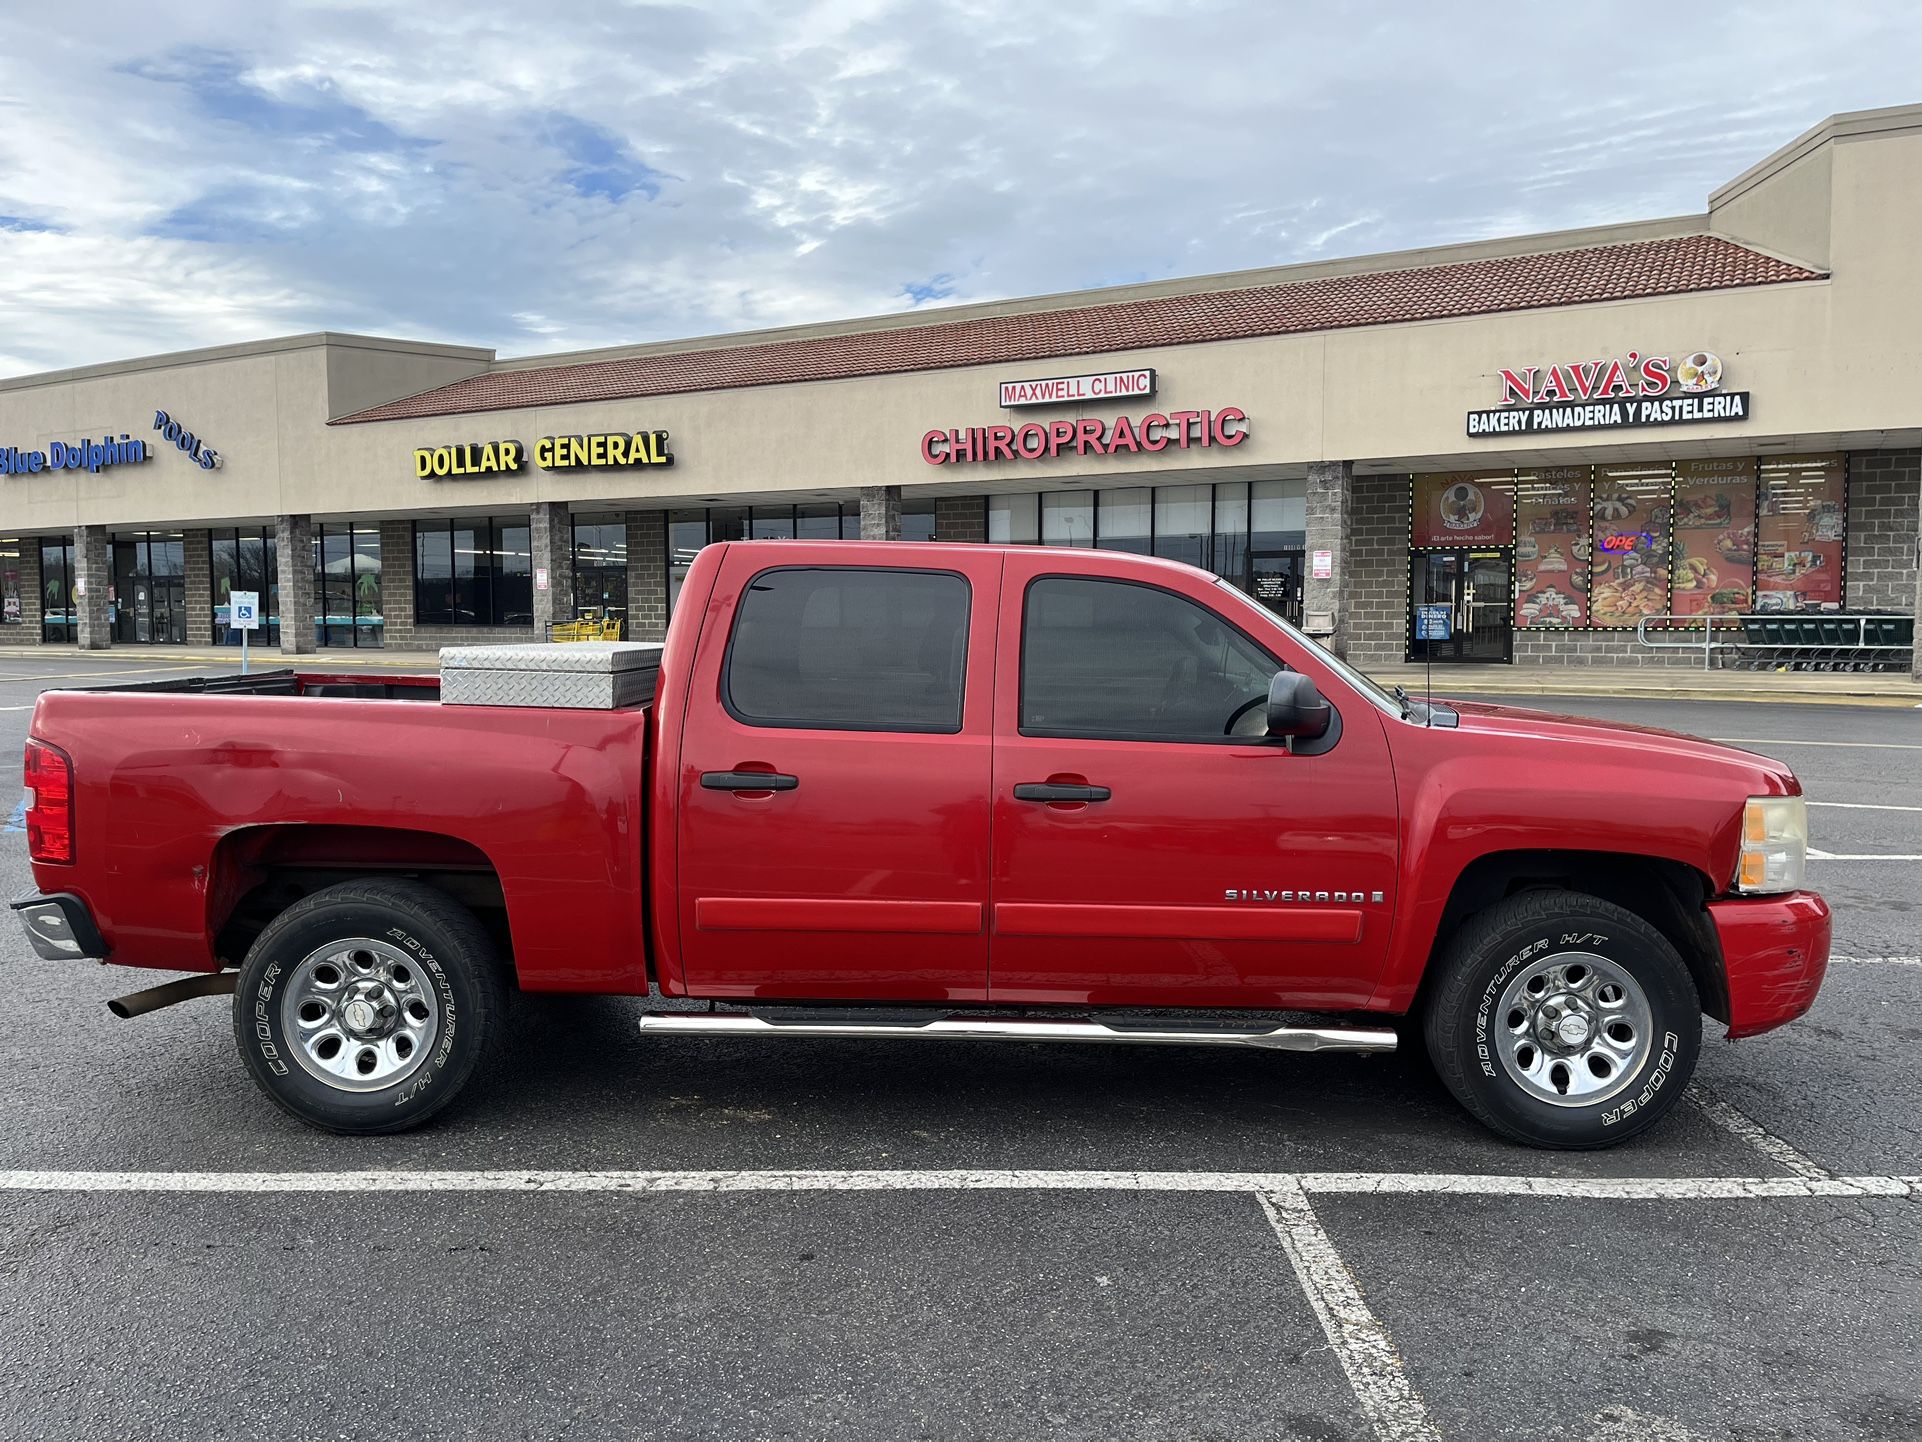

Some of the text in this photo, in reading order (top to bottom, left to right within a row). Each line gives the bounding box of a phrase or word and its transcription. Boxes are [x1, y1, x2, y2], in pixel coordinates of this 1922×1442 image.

[1003, 372, 1148, 403] MAXWELL CLINIC
[1497, 351, 1671, 405] NAVA'S
[1468, 394, 1744, 434] BAKERY PANADERIA Y PASTELERIA
[0, 433, 147, 475] Blue Dolphin
[153, 410, 217, 469] POOLS
[413, 431, 668, 478] DOLLAR GENERAL
[921, 406, 1247, 465] CHIROPRACTIC
[1530, 467, 1581, 480] Pasteles
[1574, 482, 1581, 491] Y
[1603, 481, 1612, 490] Y
[1687, 474, 1748, 486] Verduras
[1690, 461, 1745, 472] Frutas y
[1532, 495, 1578, 505] Piñatas
[1604, 536, 1636, 550] OPE
[1225, 890, 1365, 902] SILVERADO
[255, 964, 289, 1077] COOPER
[386, 928, 456, 1106] ADVENTURER H/T
[1476, 933, 1608, 1077] ADVENTURER H/T
[1601, 1031, 1679, 1126] COOPER
